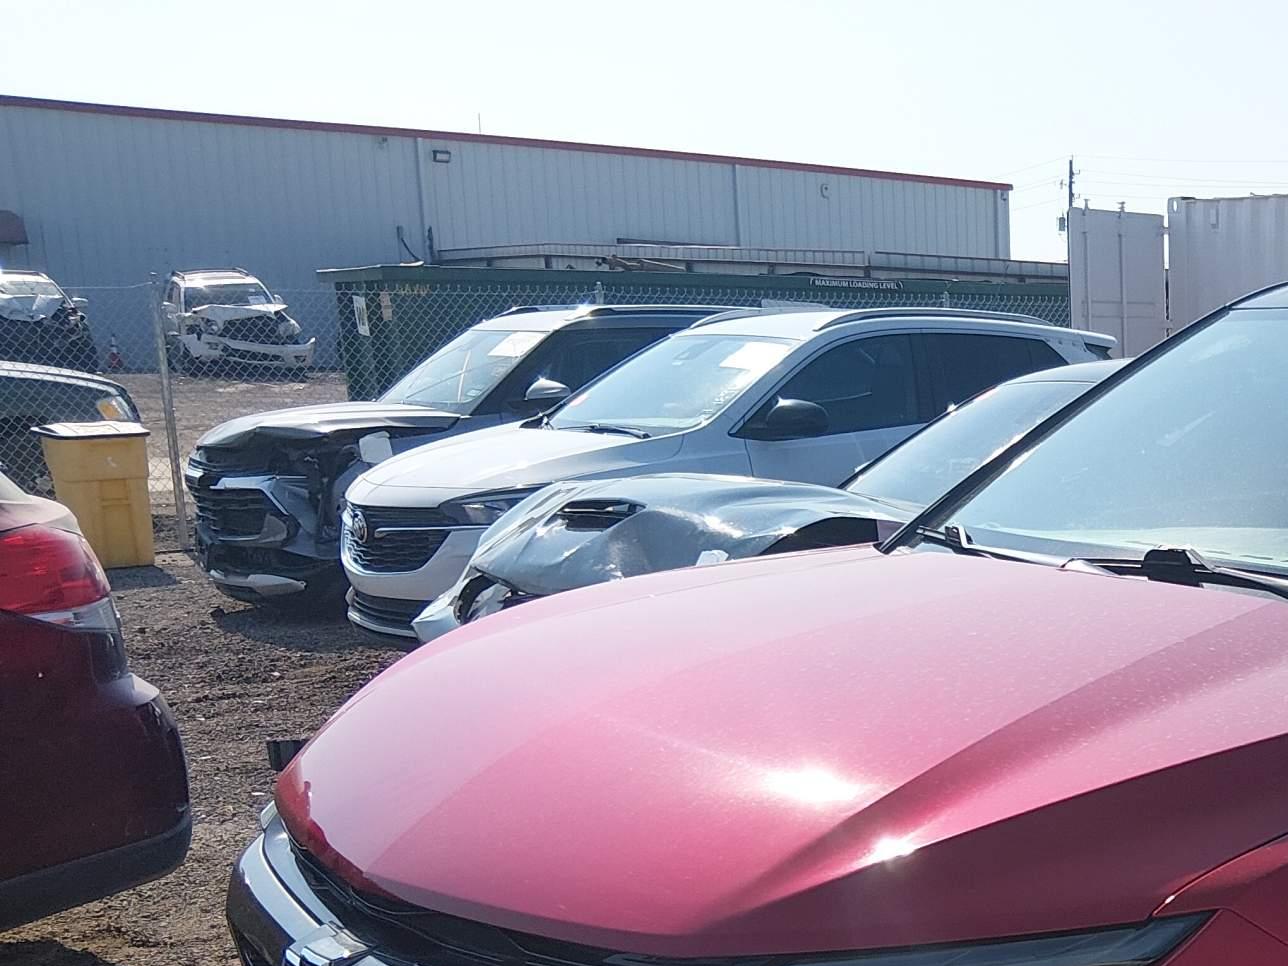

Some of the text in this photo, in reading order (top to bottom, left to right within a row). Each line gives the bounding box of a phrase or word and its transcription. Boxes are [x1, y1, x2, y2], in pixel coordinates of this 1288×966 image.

[815, 280, 898, 290] MAXIMUM LOADING LEVEL
